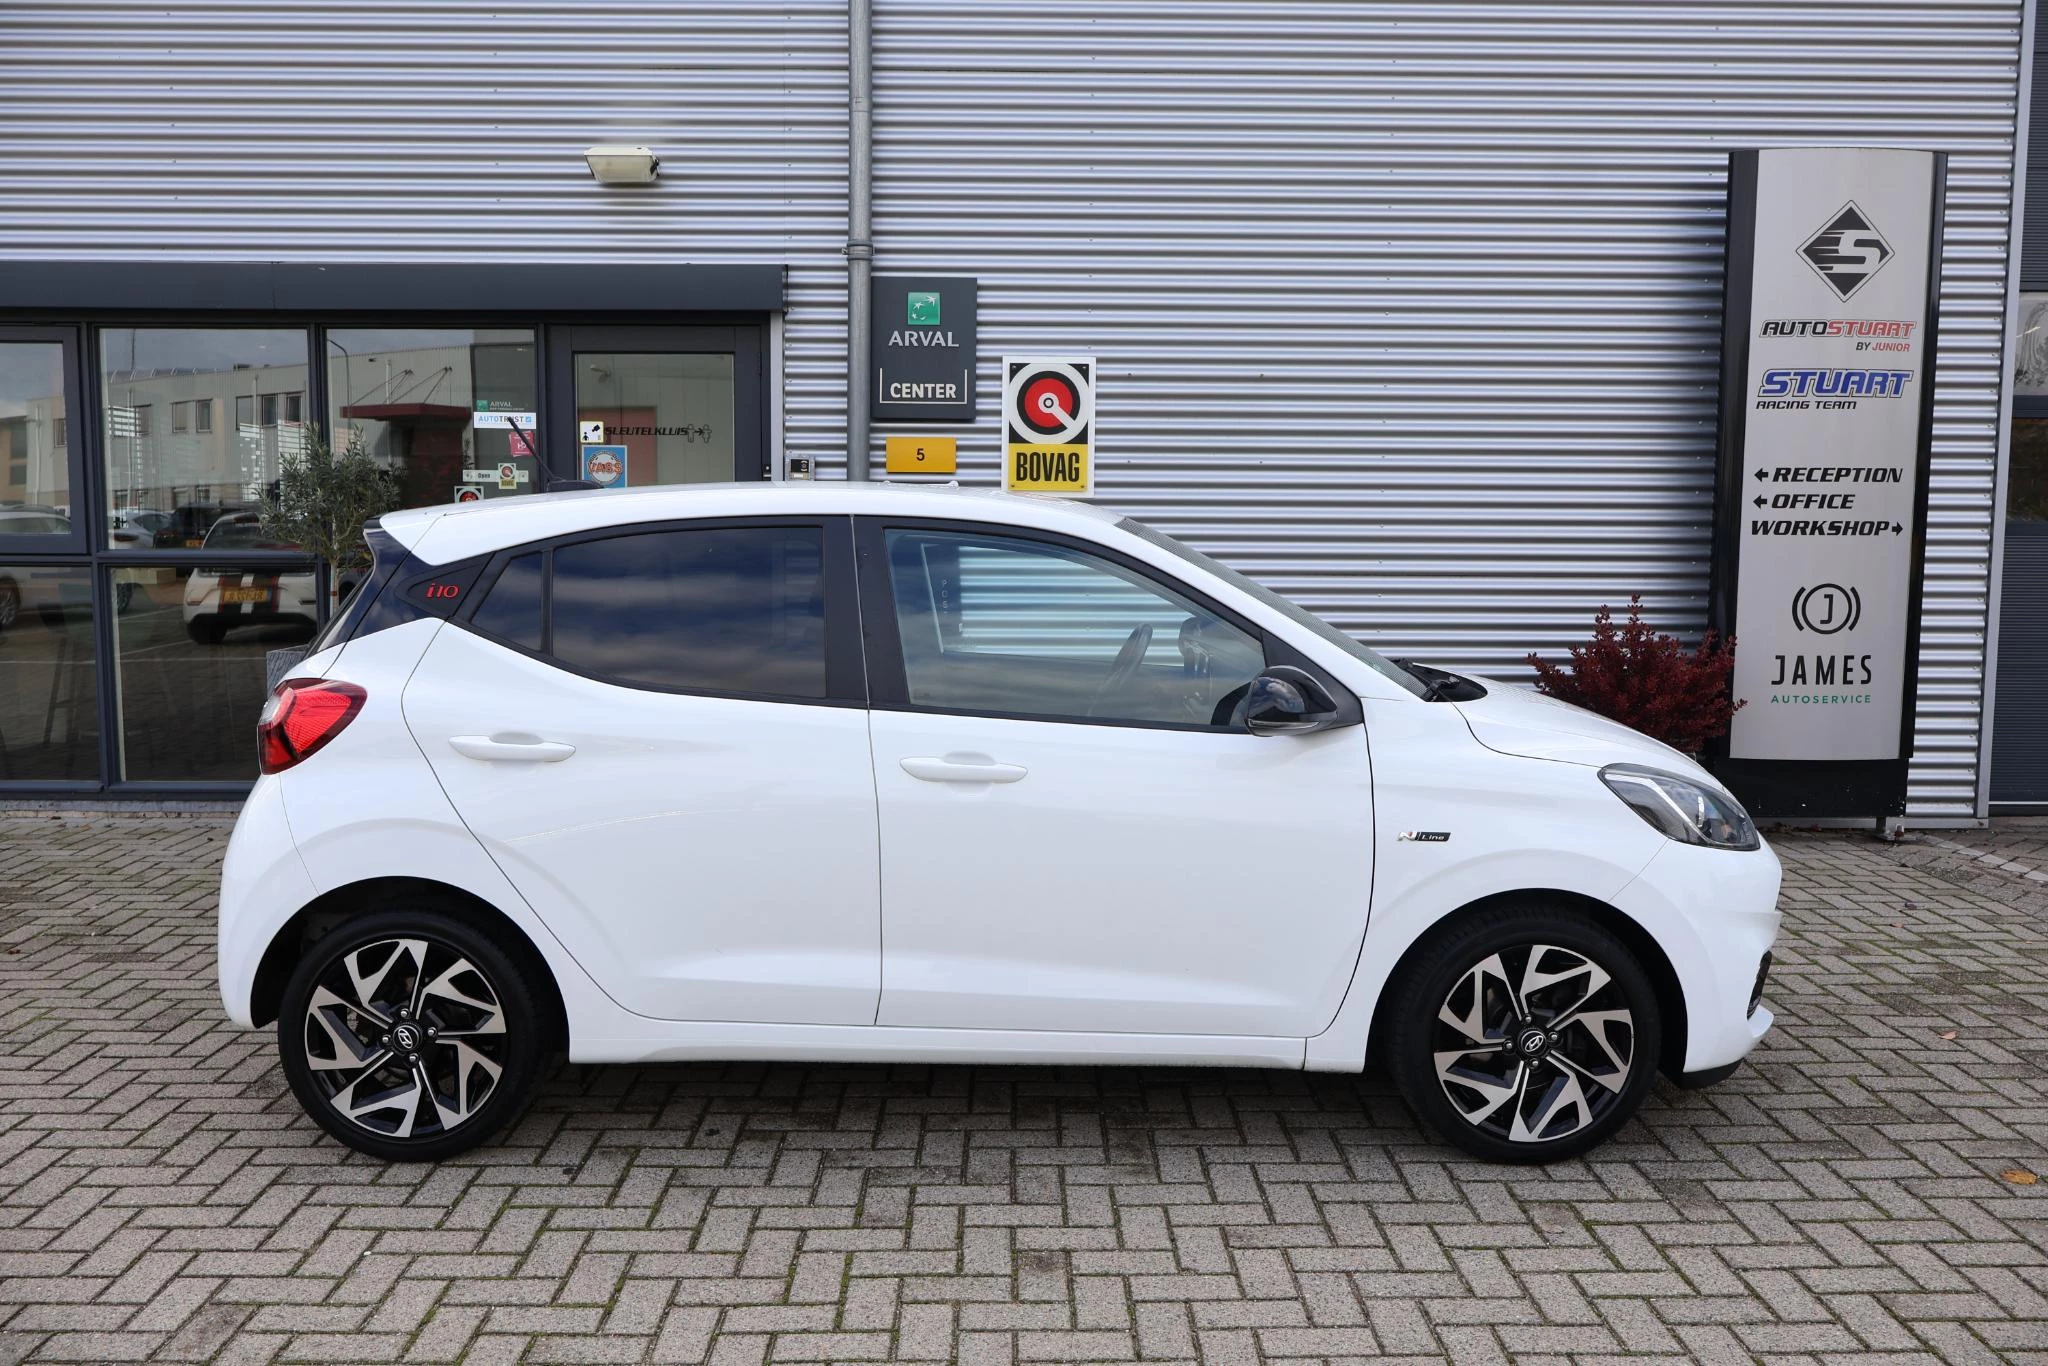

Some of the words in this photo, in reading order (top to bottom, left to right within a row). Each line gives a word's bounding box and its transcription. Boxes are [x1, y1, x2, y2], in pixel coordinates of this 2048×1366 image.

[1760, 320, 1915, 337] AUTOSTUART
[888, 330, 960, 348] ARVAL
[1855, 341, 1871, 351] BY
[1871, 342, 1911, 352] JUNIOR
[889, 382, 957, 399] CENTER
[1760, 370, 1912, 396] STUART
[1755, 400, 1810, 410] RACING
[1814, 400, 1858, 410] TEAM
[478, 415, 524, 423] AUTOTRST
[915, 447, 926, 462] 5
[1015, 451, 1081, 483] BOVAG
[1772, 467, 1904, 483] RECEPTION
[1771, 493, 1856, 510] OFFICE
[1751, 520, 1890, 536] WORKSHOP
[1771, 654, 1872, 685] JAMES
[1770, 694, 1872, 704] AUTOSERVICE
